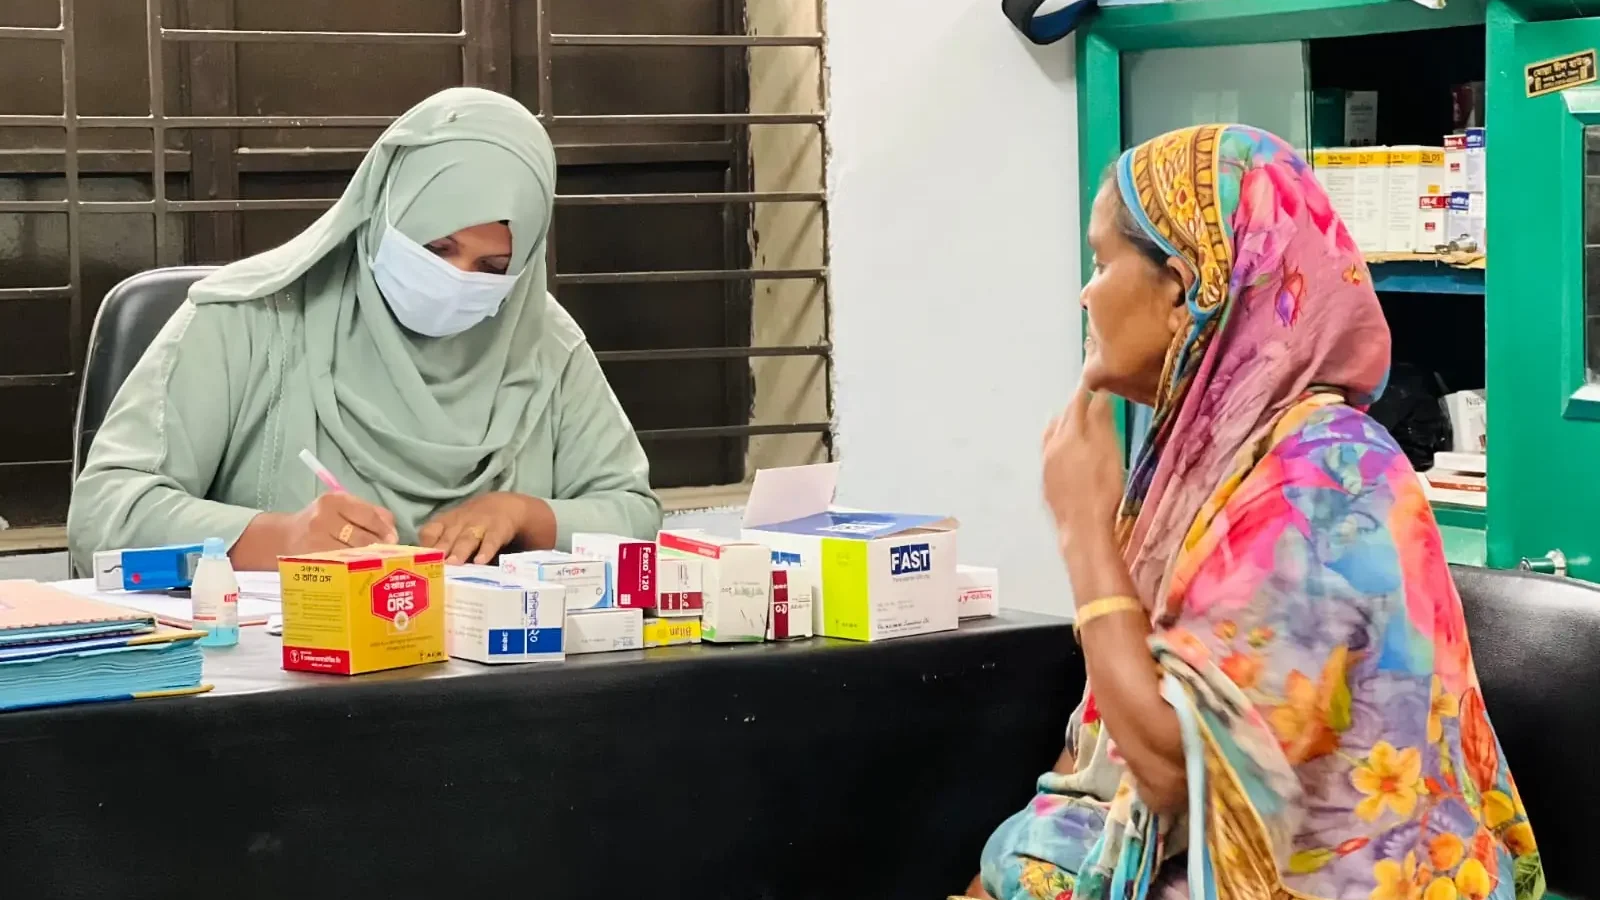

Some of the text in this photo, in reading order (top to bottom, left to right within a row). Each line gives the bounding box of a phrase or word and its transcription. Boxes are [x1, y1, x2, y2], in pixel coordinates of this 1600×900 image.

[641, 547, 651, 591] Fexo 120
[891, 549, 929, 571] FAST
[387, 597, 414, 612] ORS
[528, 629, 540, 643] ২০
